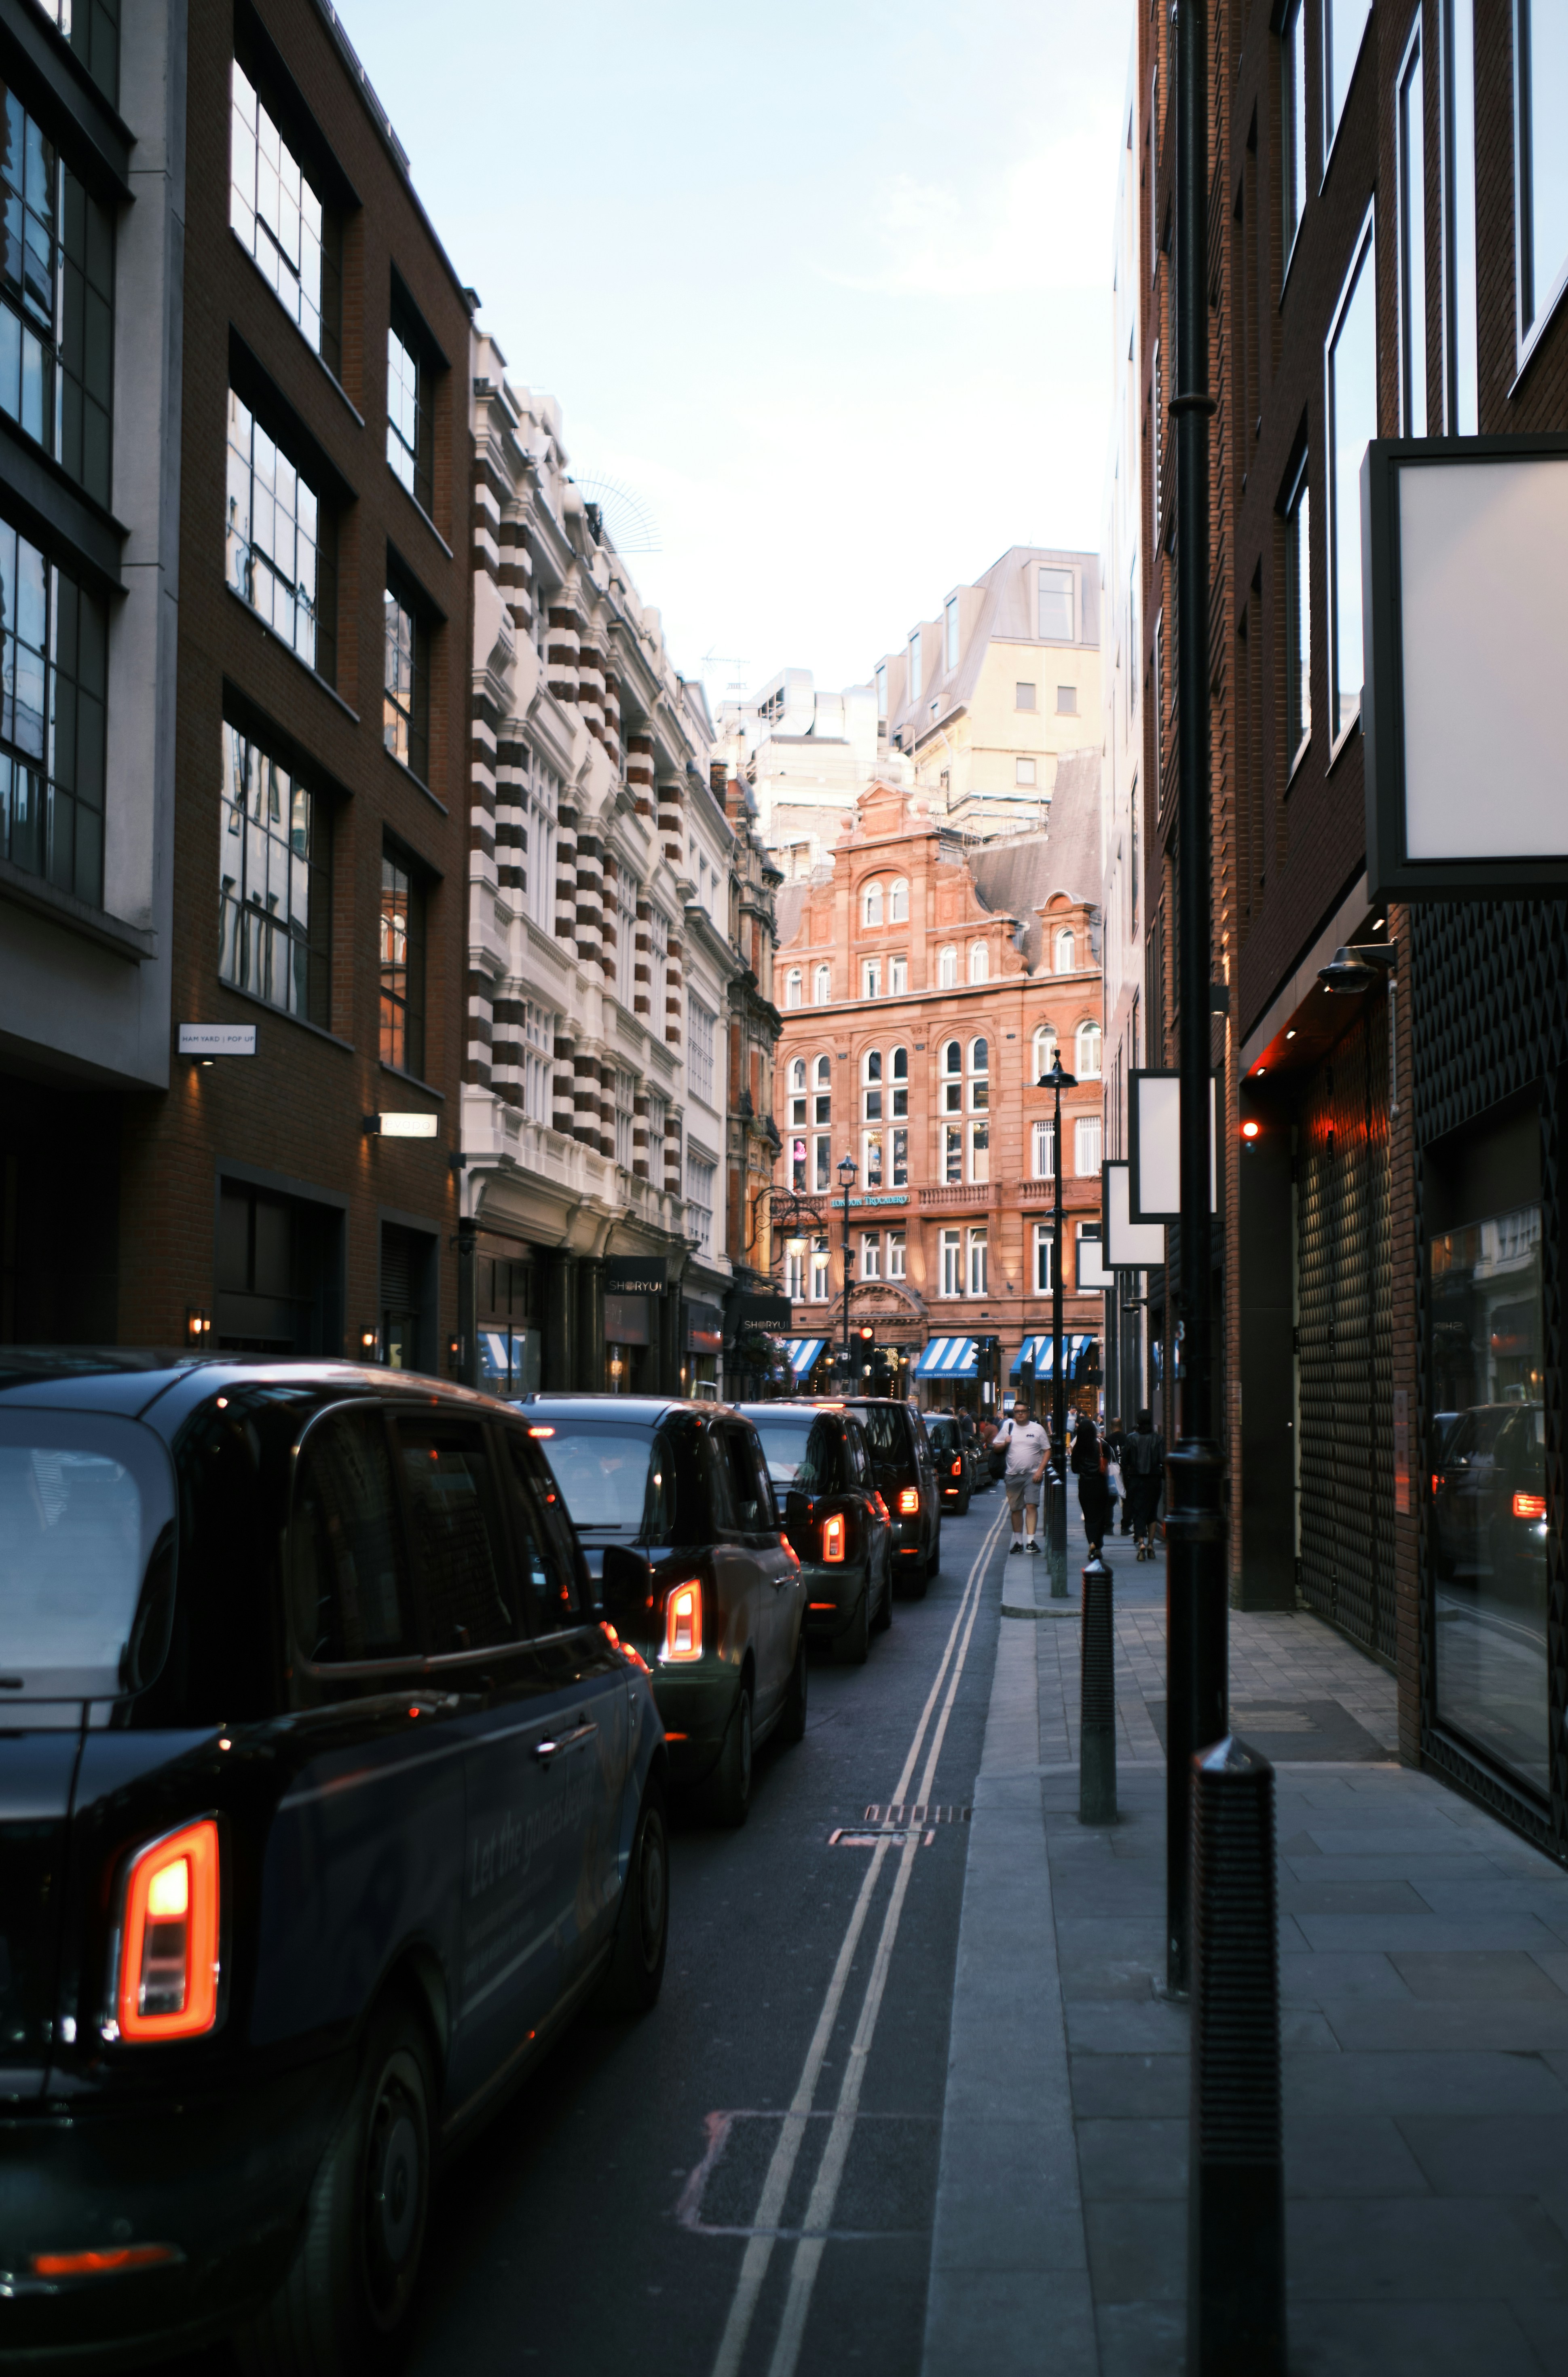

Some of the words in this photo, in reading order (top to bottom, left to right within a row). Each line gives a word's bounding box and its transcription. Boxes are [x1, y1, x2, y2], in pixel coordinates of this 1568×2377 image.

[385, 1120, 430, 1133] evapo
[610, 1281, 658, 1291] SHORYU
[744, 1320, 786, 1329] SHORYU
